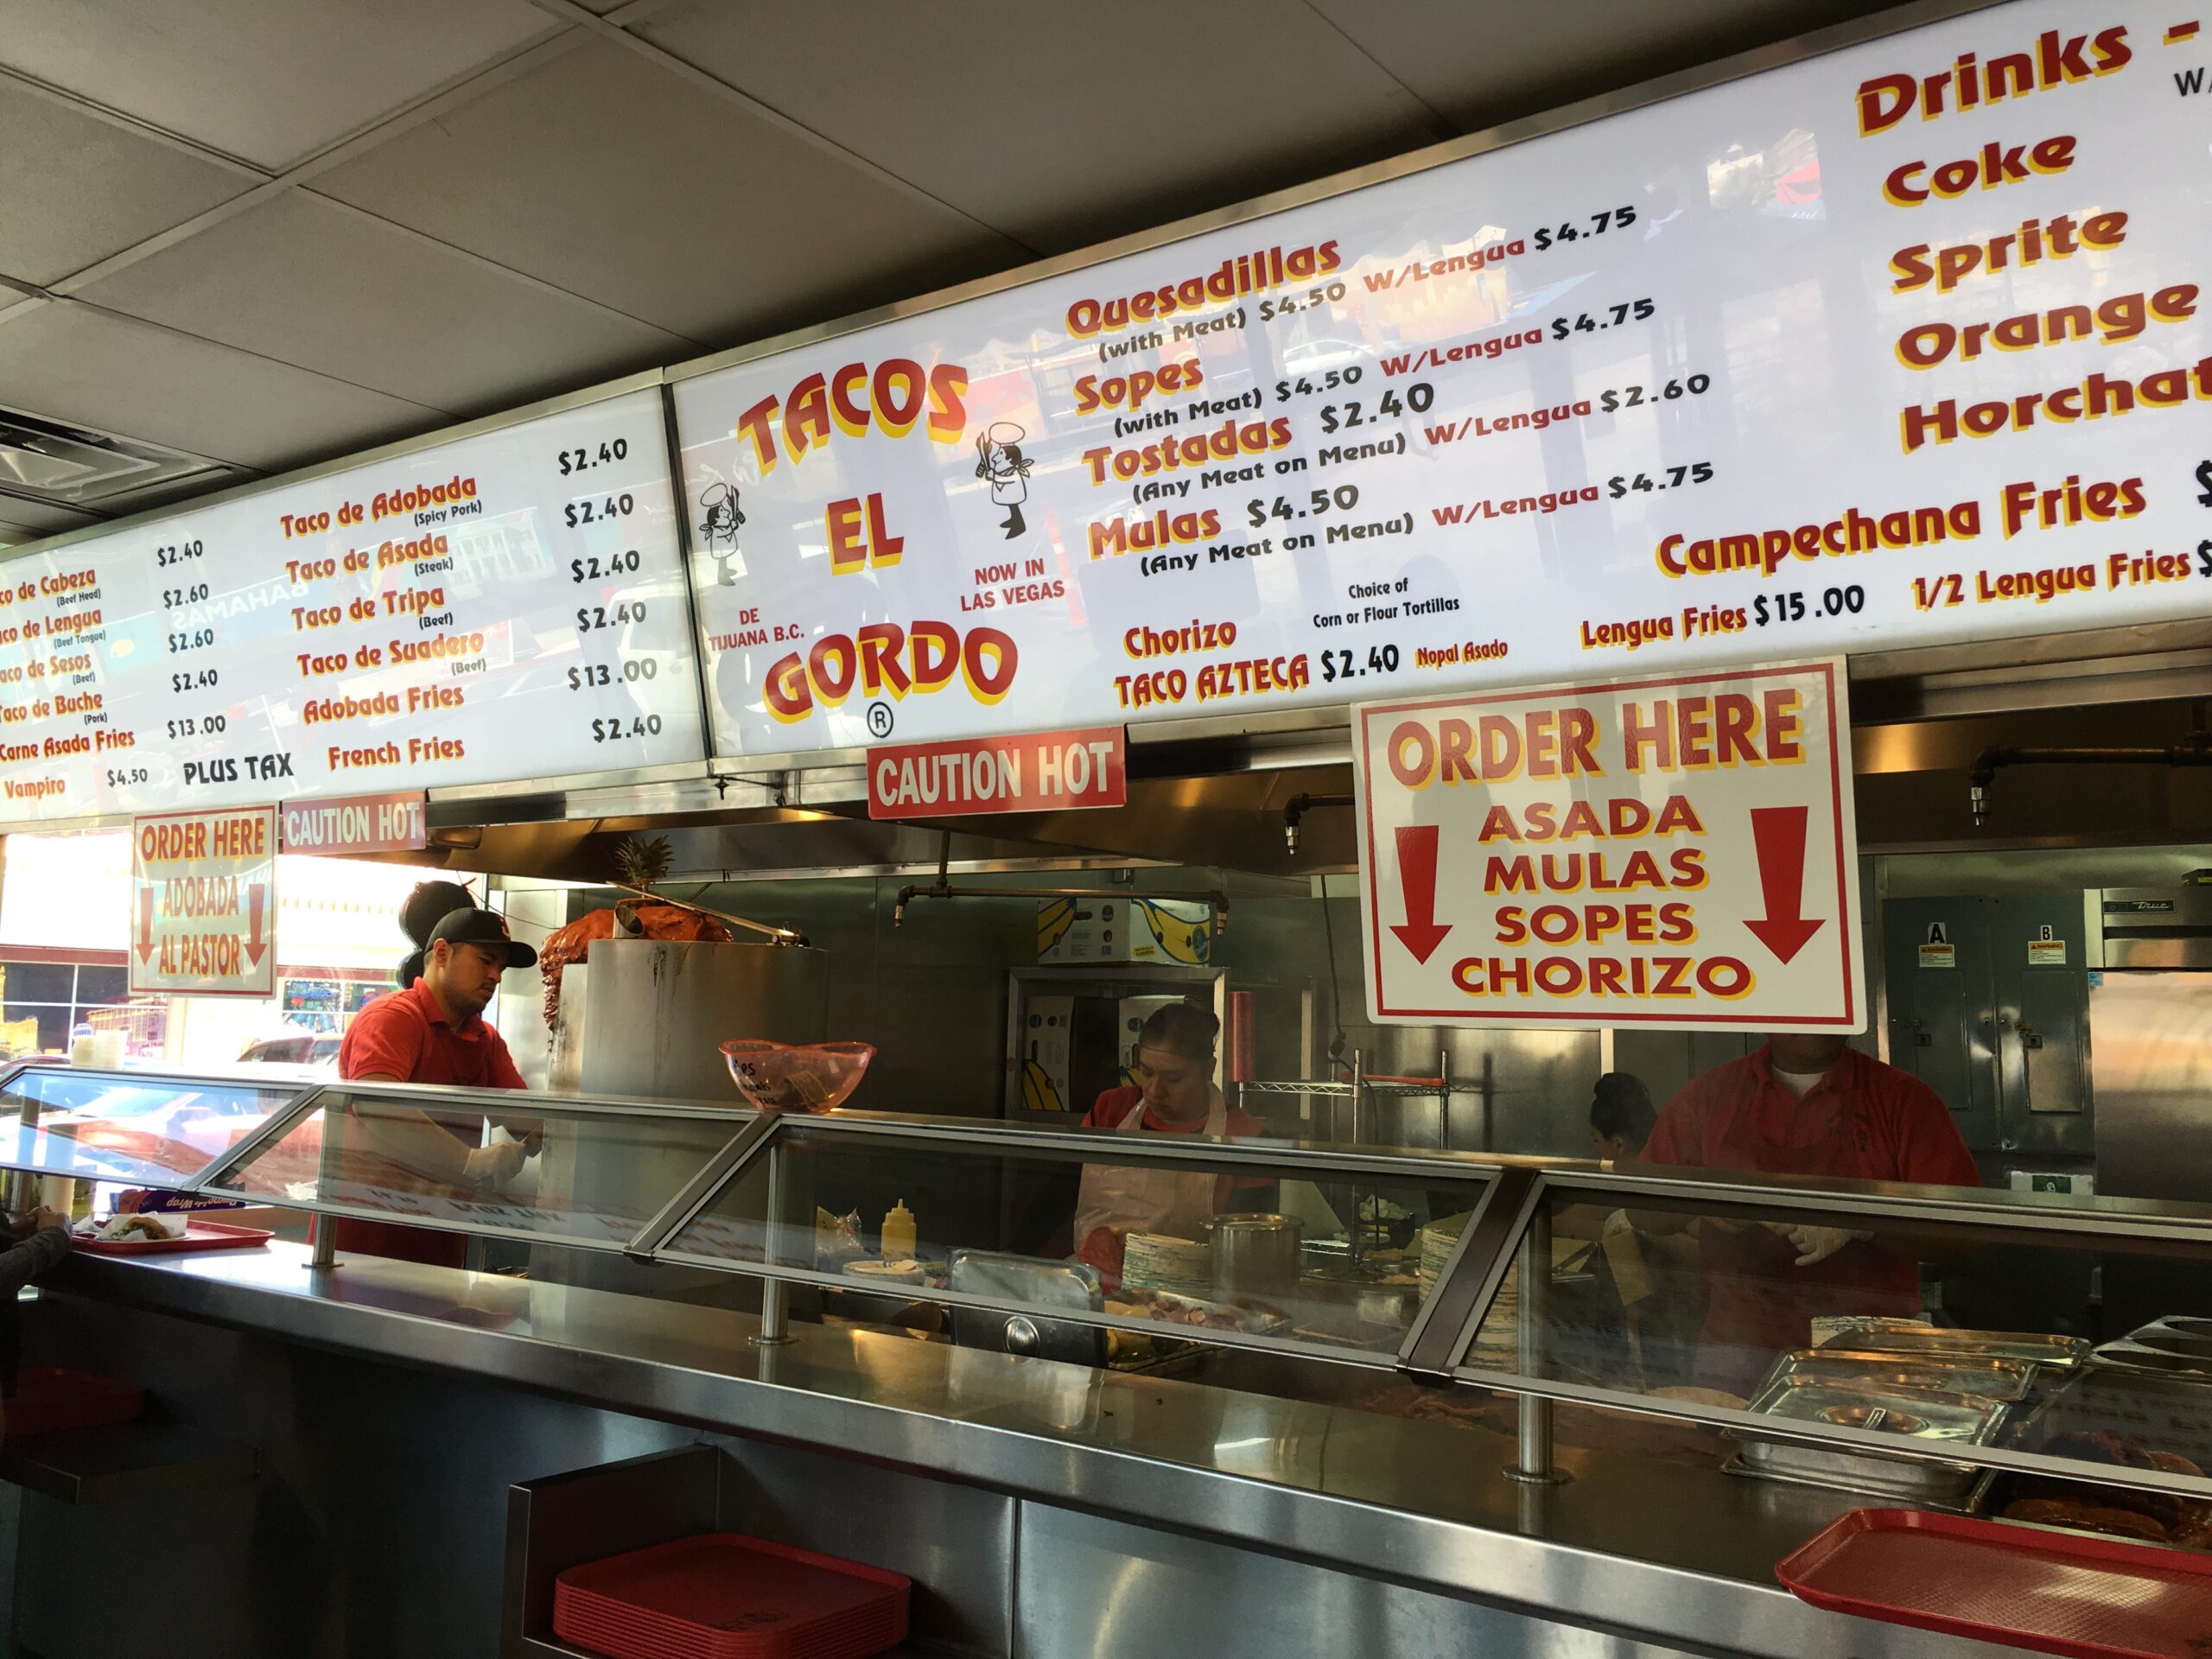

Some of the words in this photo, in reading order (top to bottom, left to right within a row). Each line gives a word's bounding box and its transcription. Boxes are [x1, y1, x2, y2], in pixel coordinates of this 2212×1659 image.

[1855, 25, 2133, 138] Drinks
[2174, 67, 2212, 97] W
[1883, 135, 2076, 207] Coke
[1888, 212, 2128, 295] Sprite
[1065, 240, 1341, 339] Quesadillas
[1099, 332, 1163, 363] (with
[1173, 308, 1247, 342] Meat)
[1259, 283, 1346, 321] $4.50
[1363, 239, 1525, 292] W/Lengua
[1534, 206, 1637, 251] $4.75
[1895, 283, 2199, 371] Orange
[1073, 358, 1204, 416] Sopes
[1115, 410, 1179, 438] (with
[1189, 387, 1262, 420] Meat)
[1275, 365, 1363, 402] $4.50
[1380, 327, 1542, 377] W/Lengua
[1552, 298, 1655, 340] $4.75
[737, 358, 969, 477] TACOS
[1082, 416, 1293, 486] Tostadas
[1320, 383, 1434, 434] $2.40
[558, 438, 628, 475] $2.40
[1133, 479, 1191, 505] (Any
[1201, 463, 1265, 489] Meat
[1274, 456, 1308, 475] on
[1319, 433, 1407, 467] Menu)
[1424, 400, 1592, 445] W/Lengua
[1600, 374, 1710, 413] $2.60
[280, 510, 330, 539] Taco
[338, 501, 364, 527] de
[371, 476, 478, 519] Adobada
[414, 508, 448, 527] (Spicy
[451, 500, 482, 518] Pork)
[564, 493, 634, 529] $2.40
[1088, 509, 1222, 562] Mulas
[1247, 485, 1359, 528] $4.50
[1141, 553, 1198, 577] (Any
[1209, 538, 1273, 563] Meat
[1282, 534, 1316, 550] on
[1326, 512, 1414, 544] Menu)
[1432, 486, 1599, 526] W/Lengua
[1607, 461, 1713, 499] $4.75
[1656, 500, 1981, 578] Campechana
[2001, 474, 2147, 540] Fries
[157, 540, 203, 567] $2.40
[825, 493, 905, 576] EL
[286, 555, 335, 585] Taco
[344, 548, 369, 572] de
[378, 532, 448, 567] Asada
[414, 556, 454, 577] (Steak)
[571, 550, 640, 583] $2.40
[975, 563, 1017, 585] NOW
[1026, 558, 1045, 576] IN
[18, 581, 36, 602] de
[40, 569, 97, 596] Cabeza
[57, 594, 77, 608] (Beef
[79, 588, 102, 603] Head)
[163, 583, 209, 609] $2.60
[961, 592, 995, 611] LAS
[1002, 580, 1065, 605] VEGAS
[1348, 581, 1390, 600] Choice
[1395, 577, 1409, 594] of
[1911, 574, 1965, 613] 1/2
[1976, 561, 2097, 603] Lengua
[2106, 550, 2191, 594] Fries
[22, 620, 41, 639] de
[44, 609, 103, 636] Lengua
[291, 602, 341, 632] Taco
[349, 596, 375, 621] de
[382, 587, 445, 614] Tripa
[419, 612, 454, 631] (Beef)
[577, 601, 646, 632] $2.40
[739, 609, 760, 626] DE
[1313, 613, 1342, 629] Corn
[1346, 612, 1361, 626] or
[1364, 605, 1398, 624] Flour
[1402, 597, 1460, 618] Tortillas
[1580, 615, 1675, 650] Lengua
[1681, 604, 1748, 642] Fries
[1754, 584, 1866, 627] $15.00
[54, 636, 74, 650] (Beef
[76, 629, 106, 645] Tongue)
[168, 628, 214, 653] $2.60
[297, 650, 347, 677] Taco
[355, 644, 381, 668] de
[390, 632, 484, 665] Suadero
[709, 629, 767, 652] TIJUANA
[774, 624, 804, 642] B.C.
[1123, 619, 1236, 658] Chorizo
[28, 659, 45, 679] de
[49, 653, 92, 676] Sesos
[73, 671, 96, 686] (Beef)
[172, 670, 218, 693] $2.40
[451, 658, 486, 676] (Beef)
[568, 658, 657, 690] $13.00
[763, 620, 1019, 724] GORDO
[1113, 669, 1187, 709] TACO
[1196, 653, 1310, 703] AZTECA
[1321, 644, 1400, 683] $2.40
[1414, 645, 1459, 671] Nopal
[1462, 639, 1509, 662] Asado
[32, 698, 51, 719] de
[54, 691, 103, 716] Buche
[84, 712, 108, 726] (Pork)
[302, 691, 400, 726] Adobada
[408, 683, 465, 715] Fries
[0, 742, 39, 764] Carne
[43, 733, 91, 760] Asada
[94, 728, 136, 754] Fries
[167, 715, 226, 740] $13.00
[592, 714, 662, 742] $2.40
[1387, 707, 1605, 791] ORDER
[1622, 688, 1807, 774] HERE
[328, 740, 400, 772] French
[409, 736, 465, 766] Fries
[876, 748, 1021, 807] CAUTION
[1038, 741, 1114, 796] HOT
[3, 776, 67, 801] Vampiro
[107, 768, 148, 788] $4.50
[183, 759, 238, 785] PLUS
[245, 753, 295, 779] TAX
[141, 821, 208, 862] ORDER
[213, 817, 268, 859] HERE
[287, 805, 370, 847] CAUTION
[378, 801, 420, 841] HOT
[1478, 795, 1708, 844] ASADA
[1484, 848, 1710, 895] MULAS
[162, 874, 240, 919] ADOBADA
[1495, 902, 1699, 946] SOPES
[1929, 923, 1945, 944] A
[2042, 926, 2051, 941] B
[158, 934, 178, 976] AL
[181, 932, 242, 976] PASTOR
[1451, 956, 1757, 1001] CHORIZO
